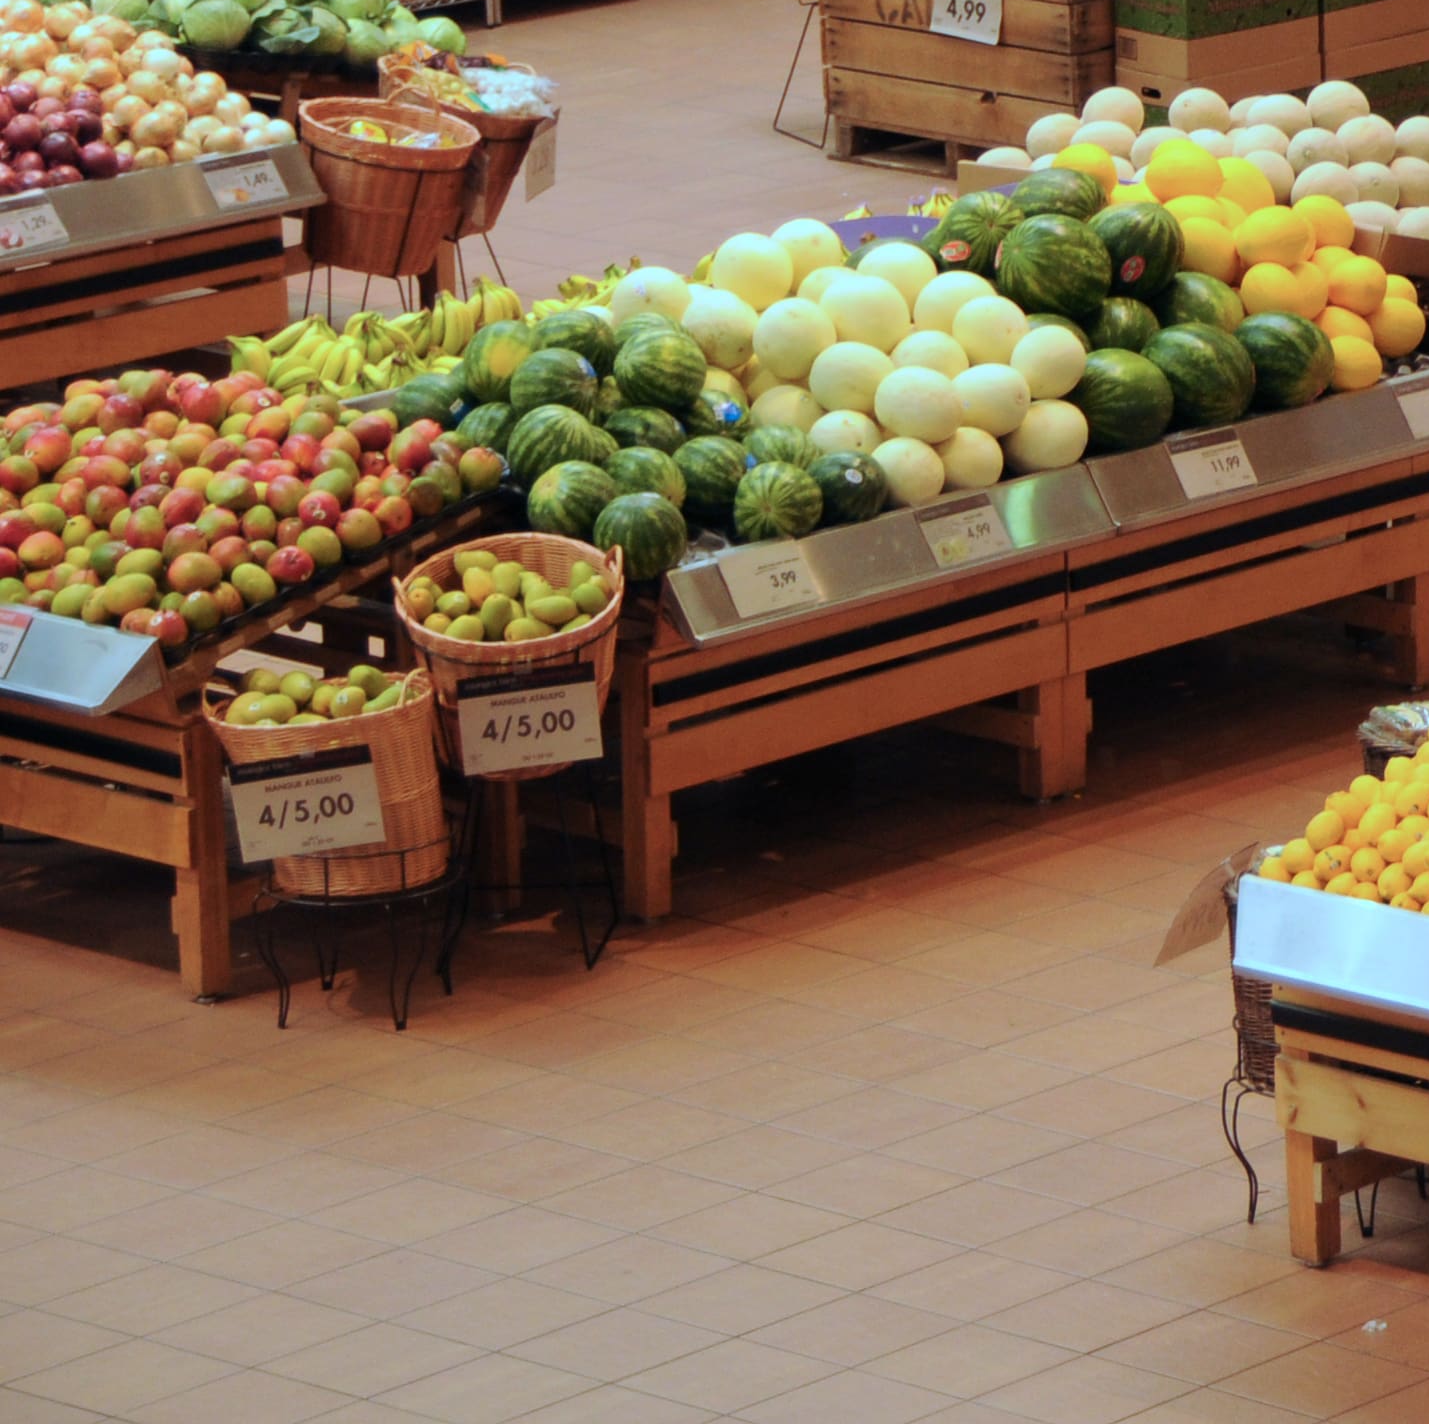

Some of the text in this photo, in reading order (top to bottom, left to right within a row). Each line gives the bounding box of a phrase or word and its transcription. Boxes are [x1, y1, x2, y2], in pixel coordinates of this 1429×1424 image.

[243, 172, 268, 188] 1,49
[22, 215, 46, 231] 1,29
[1211, 455, 1240, 473] 11,99
[967, 523, 991, 540] 4,99
[769, 570, 797, 589] 3,99
[490, 691, 567, 708] MANGUE ATAULFO
[482, 708, 575, 744] 4/5,00
[265, 774, 343, 793] MANGUE ATAULFO
[258, 792, 355, 830] 4/5,00
